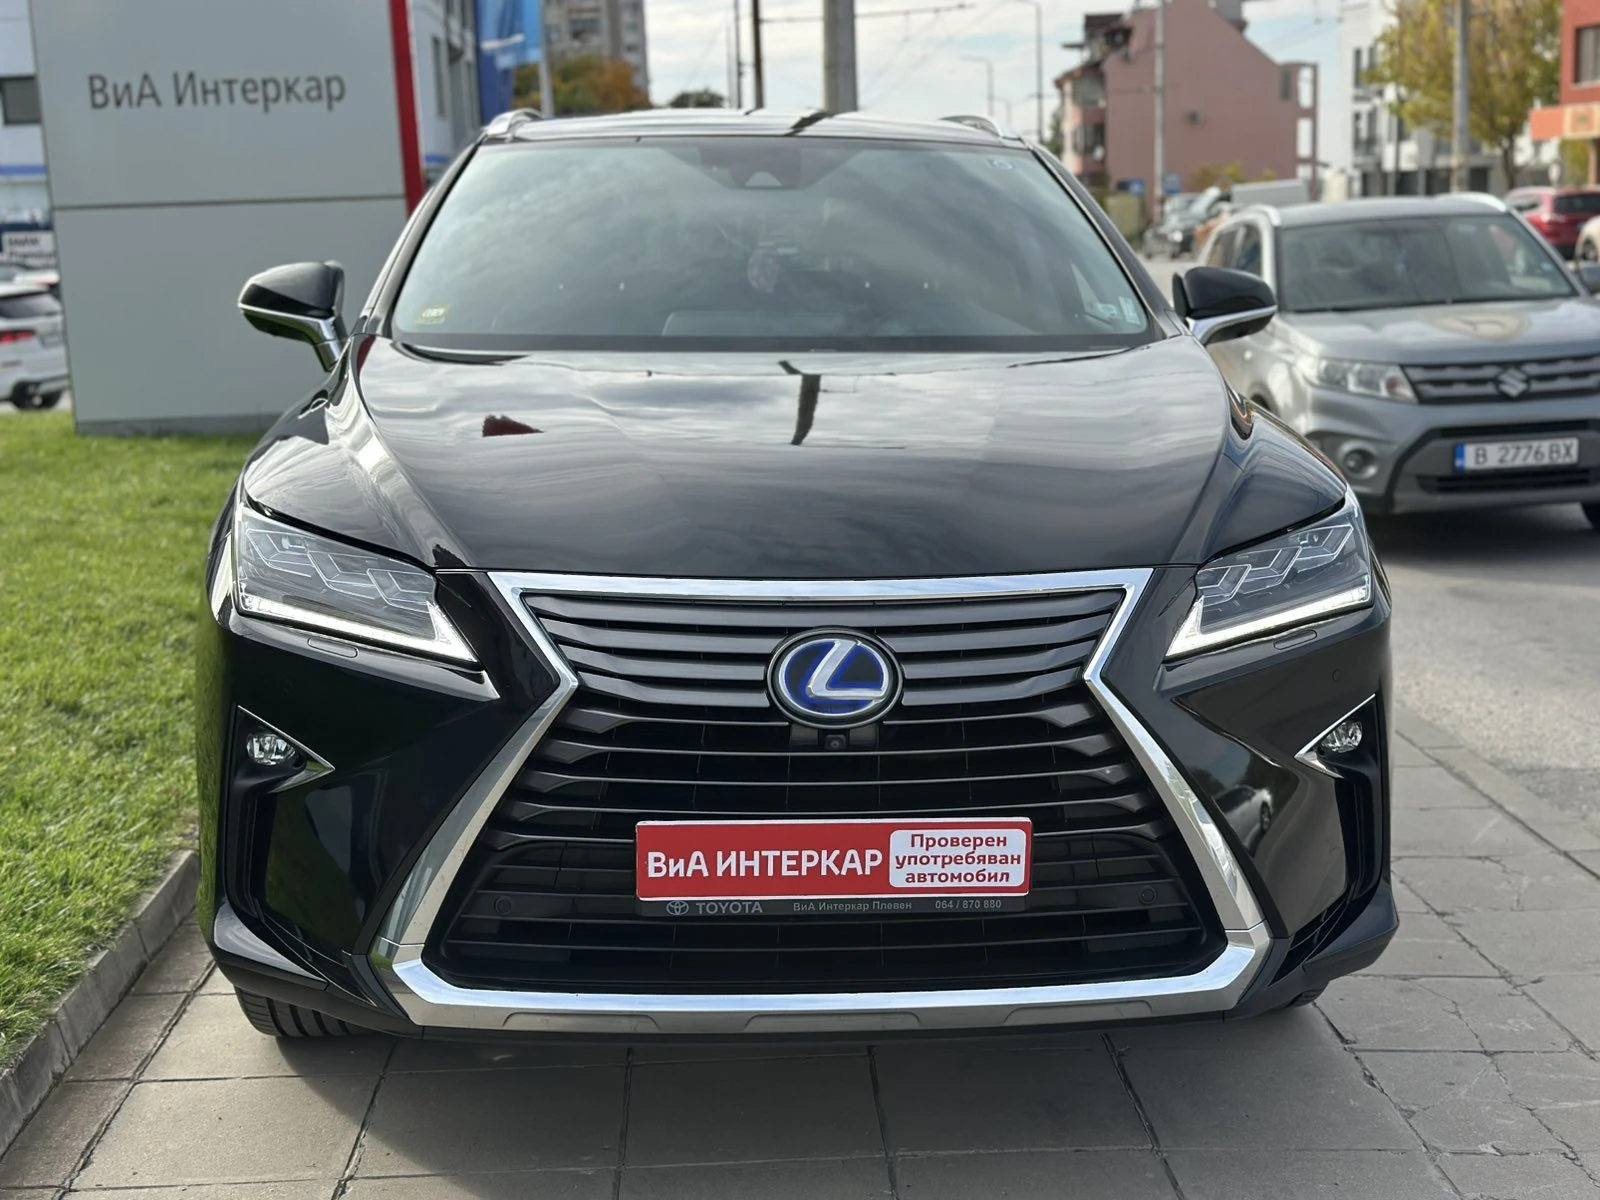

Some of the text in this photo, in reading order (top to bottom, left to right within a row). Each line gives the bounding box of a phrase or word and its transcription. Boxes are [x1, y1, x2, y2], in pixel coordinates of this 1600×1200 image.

[88, 71, 346, 114] ВиА Интеркар
[911, 834, 1007, 850] Проверен
[648, 849, 883, 878] ВиА ИНТЕРКАР
[895, 850, 1021, 869] употребяван
[905, 868, 1010, 884] автомобил
[696, 902, 763, 914] TOYOTA
[793, 901, 912, 912] ВиА Интеркар Плевен
[935, 900, 953, 909] 064
[962, 900, 980, 909] 870
[983, 899, 1002, 909] 880
